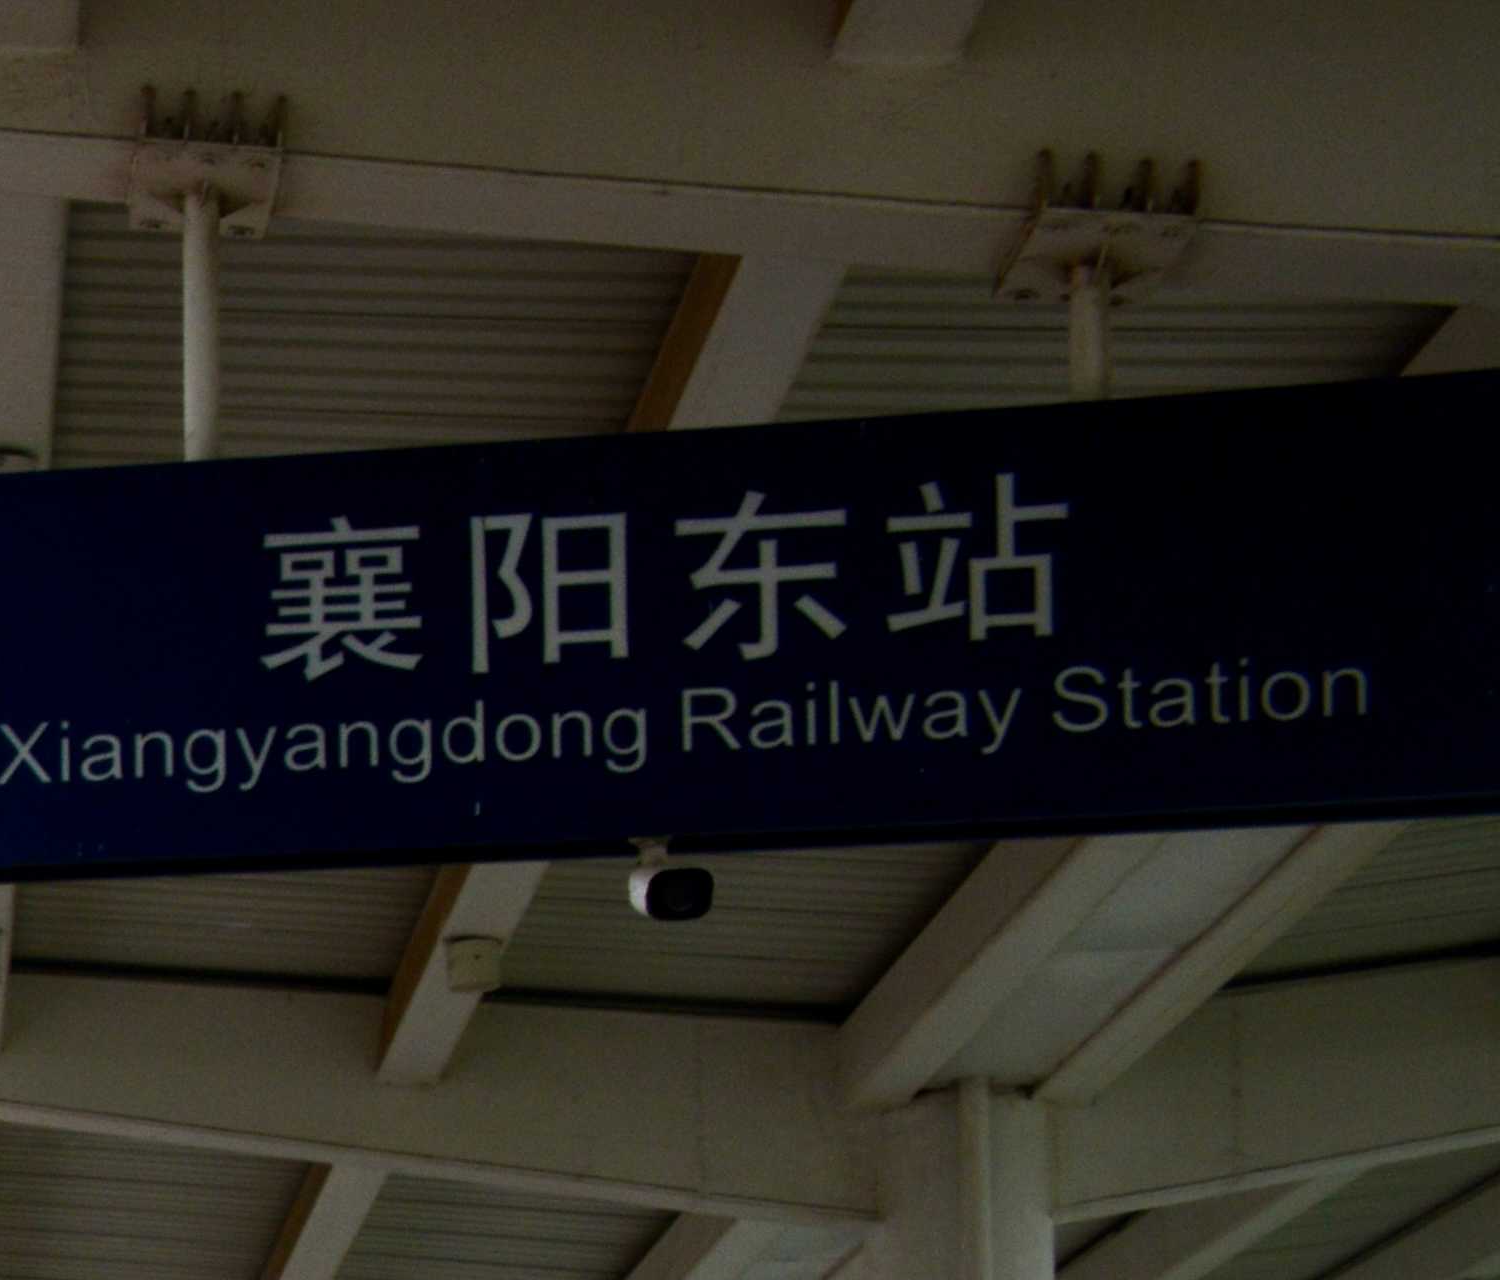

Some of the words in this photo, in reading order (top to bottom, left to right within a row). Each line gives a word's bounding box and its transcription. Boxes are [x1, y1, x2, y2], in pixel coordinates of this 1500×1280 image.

[259, 472, 1070, 681] 襄阳东站
[681, 681, 1021, 754] Railway
[1053, 659, 1367, 732] Station
